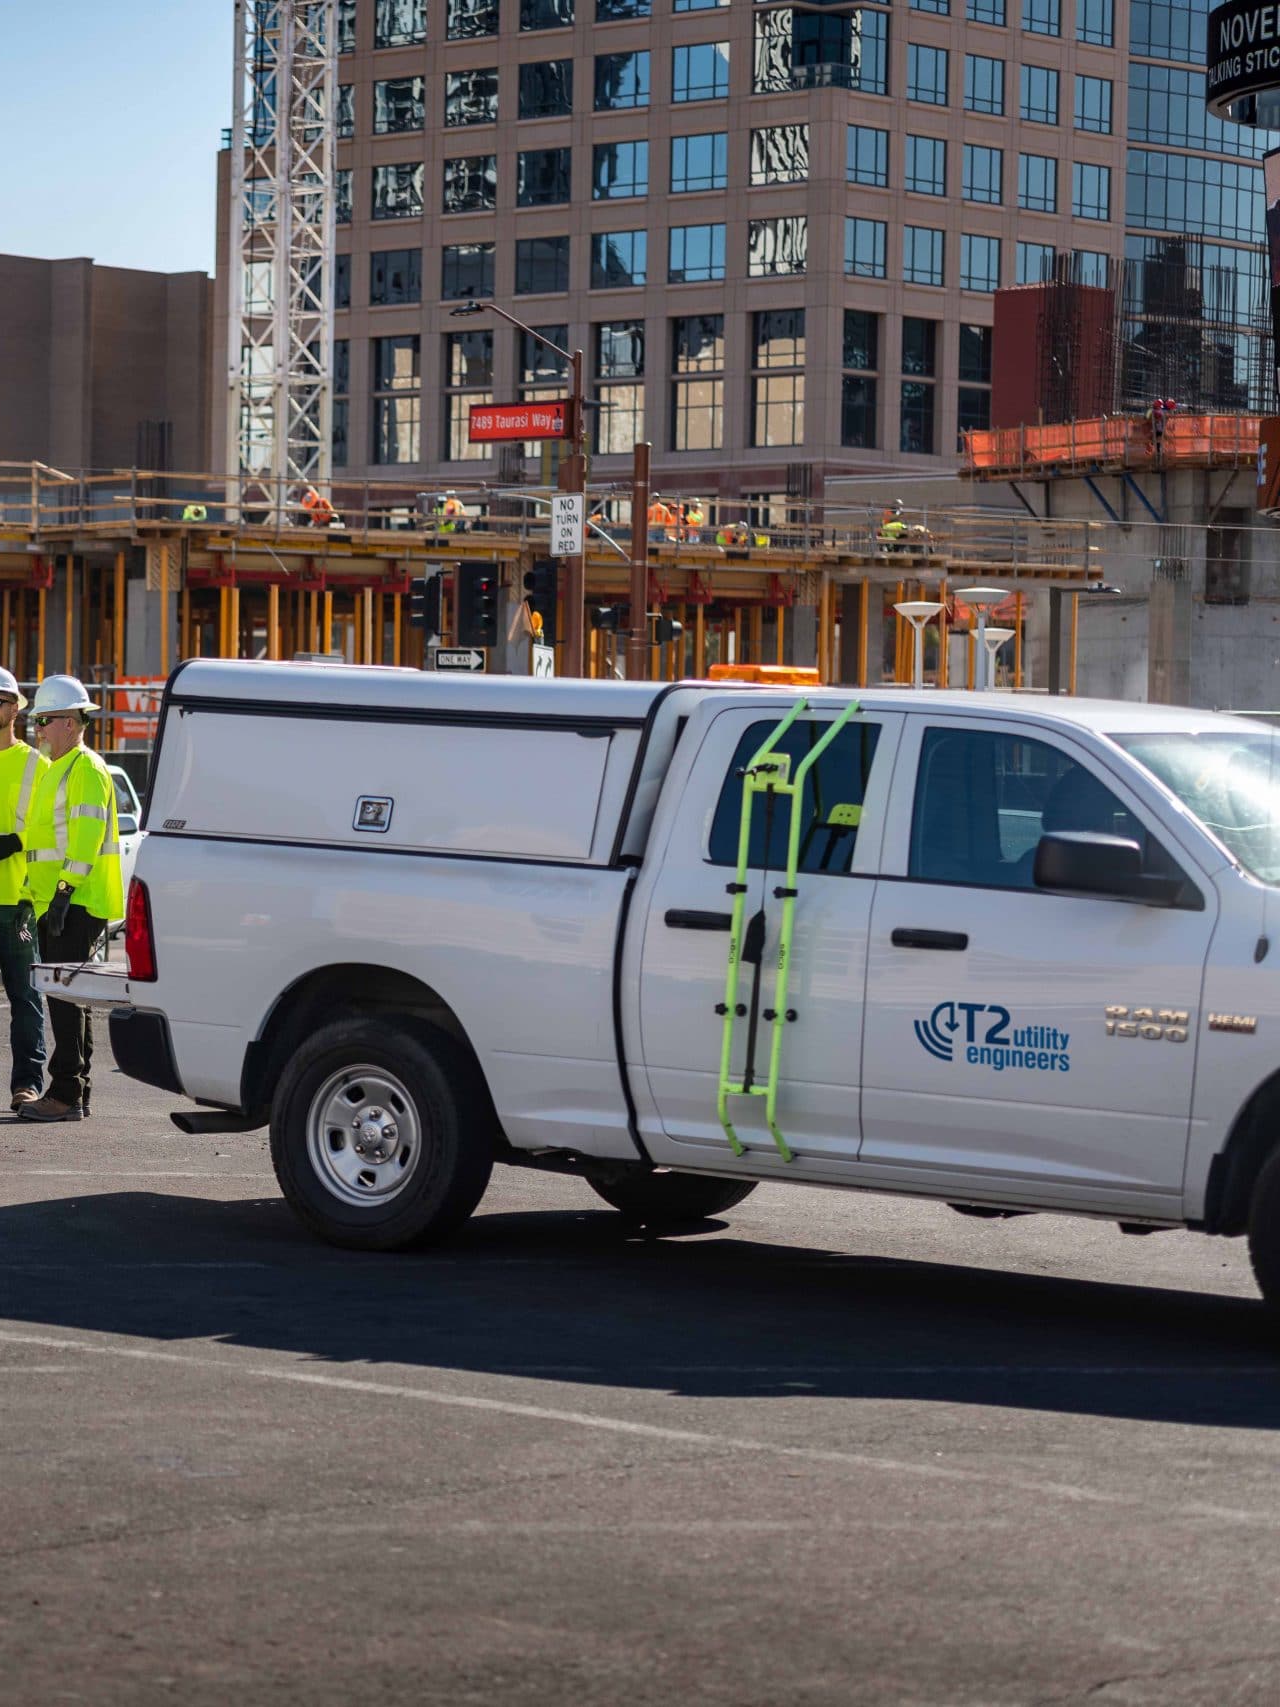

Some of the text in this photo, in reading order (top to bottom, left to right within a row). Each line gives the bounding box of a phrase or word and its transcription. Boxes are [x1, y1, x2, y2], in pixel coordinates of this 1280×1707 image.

[1220, 4, 1280, 53] NOVE
[496, 413, 528, 428] Taurasi
[532, 413, 551, 430] Way
[560, 498, 575, 511] NO
[556, 514, 579, 525] TURN
[560, 527, 573, 538] ON
[558, 540, 575, 551] RED
[440, 654, 471, 665] ONE WAY
[1105, 1005, 1189, 1025] RAM
[1208, 1012, 1257, 1034] HEMI
[958, 1002, 1070, 1050] T2 utility
[1105, 1021, 1189, 1043] 1500
[966, 1046, 1070, 1072] engineers
